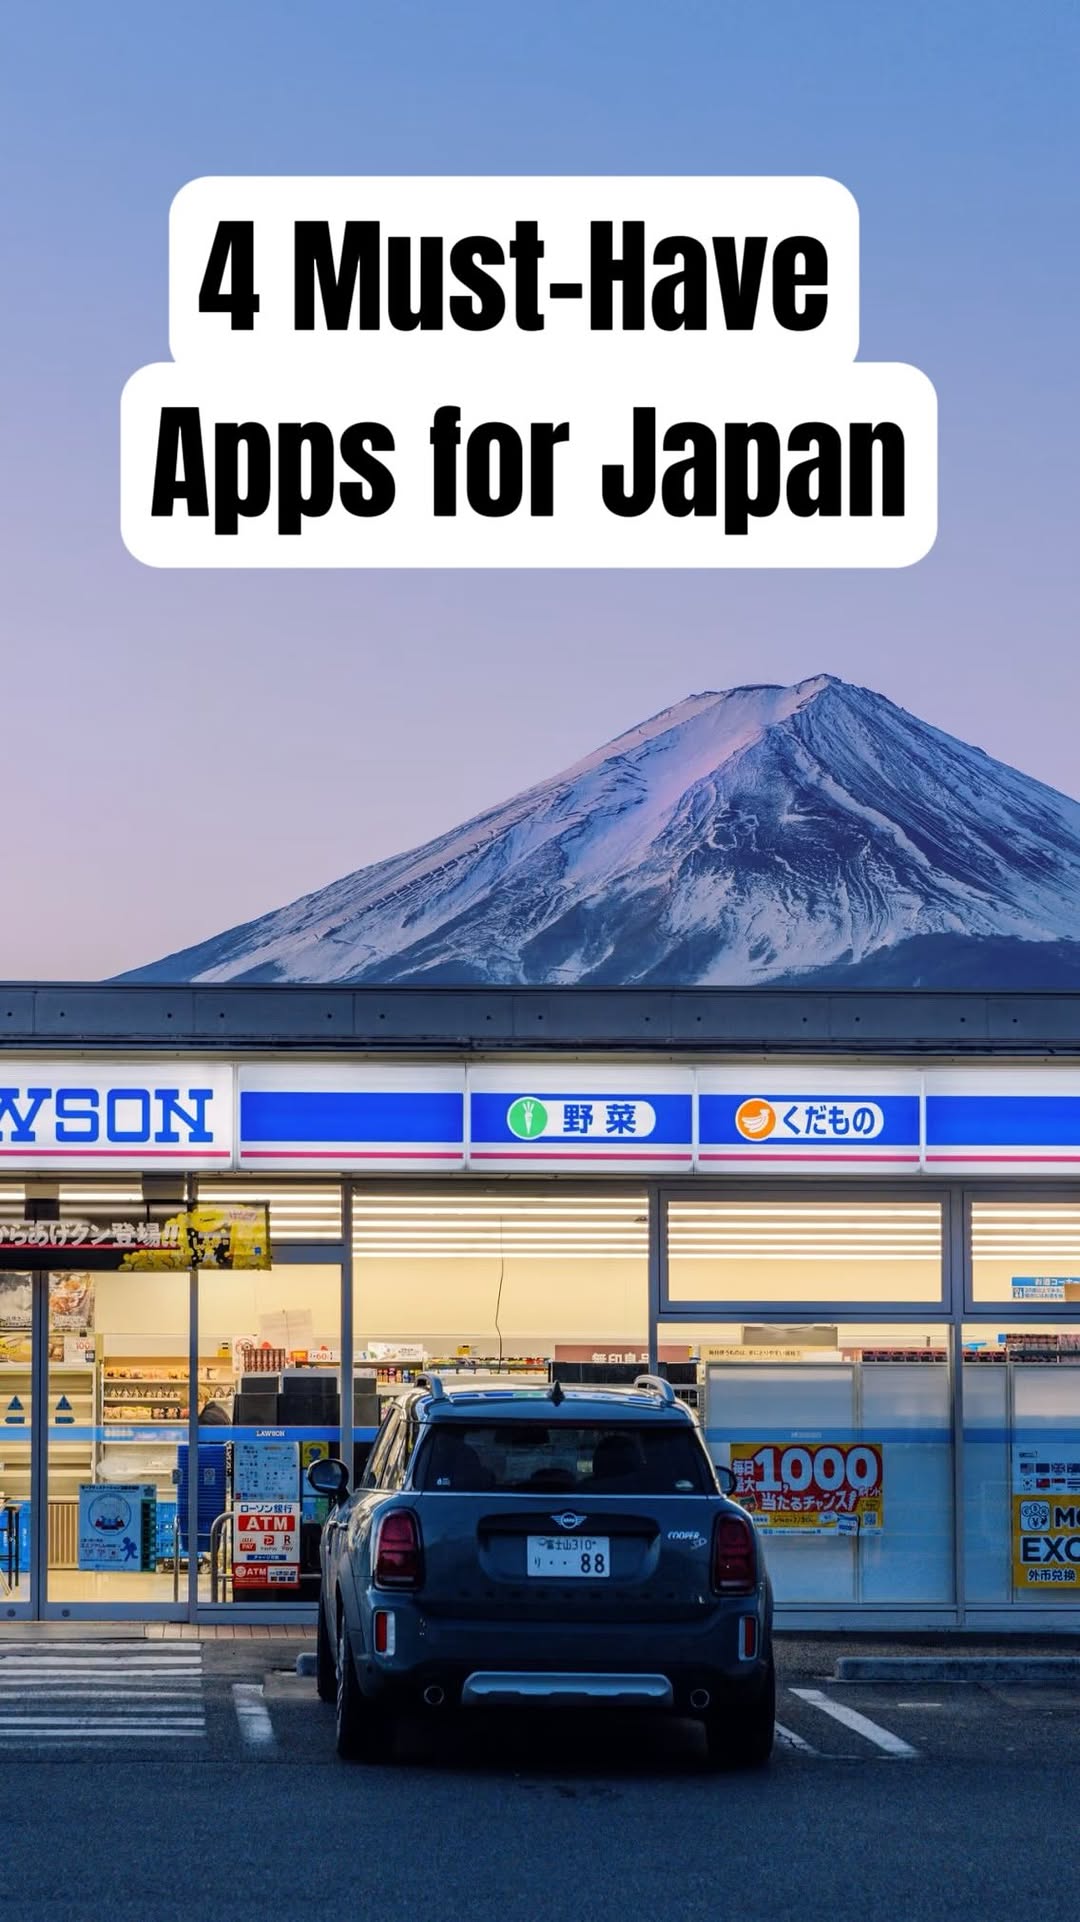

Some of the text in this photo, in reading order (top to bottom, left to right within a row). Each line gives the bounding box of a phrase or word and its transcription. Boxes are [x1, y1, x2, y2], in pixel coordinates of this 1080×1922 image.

[562, 1103, 637, 1135] 野菜
[782, 1105, 876, 1136] くだもの
[733, 1460, 755, 1476] 毎日
[240, 1504, 293, 1514] ローソン銀行
[245, 1516, 288, 1531] ATM
[667, 1531, 701, 1540] COOPER
[580, 1552, 605, 1574] 88
[246, 1567, 267, 1576] ATM
